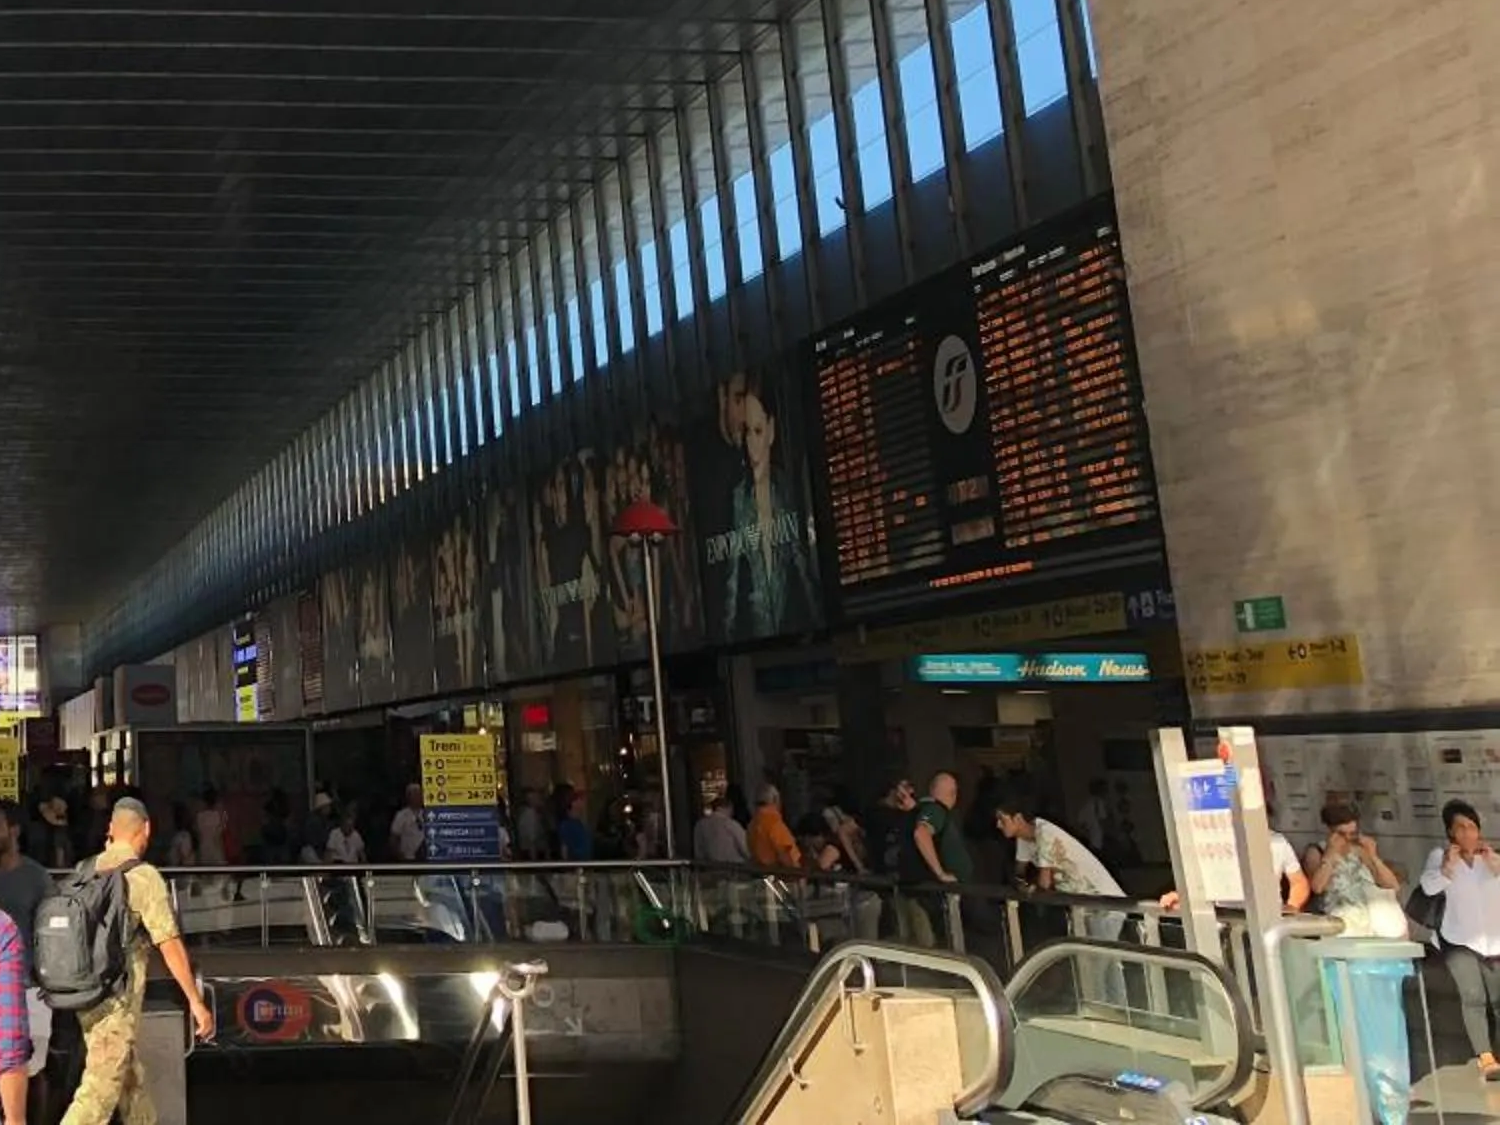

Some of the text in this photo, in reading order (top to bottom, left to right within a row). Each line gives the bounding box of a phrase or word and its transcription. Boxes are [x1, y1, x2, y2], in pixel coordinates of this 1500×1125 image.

[1016, 659, 1088, 678] Hudson
[1098, 659, 1150, 677] News
[428, 738, 462, 752] Treni
